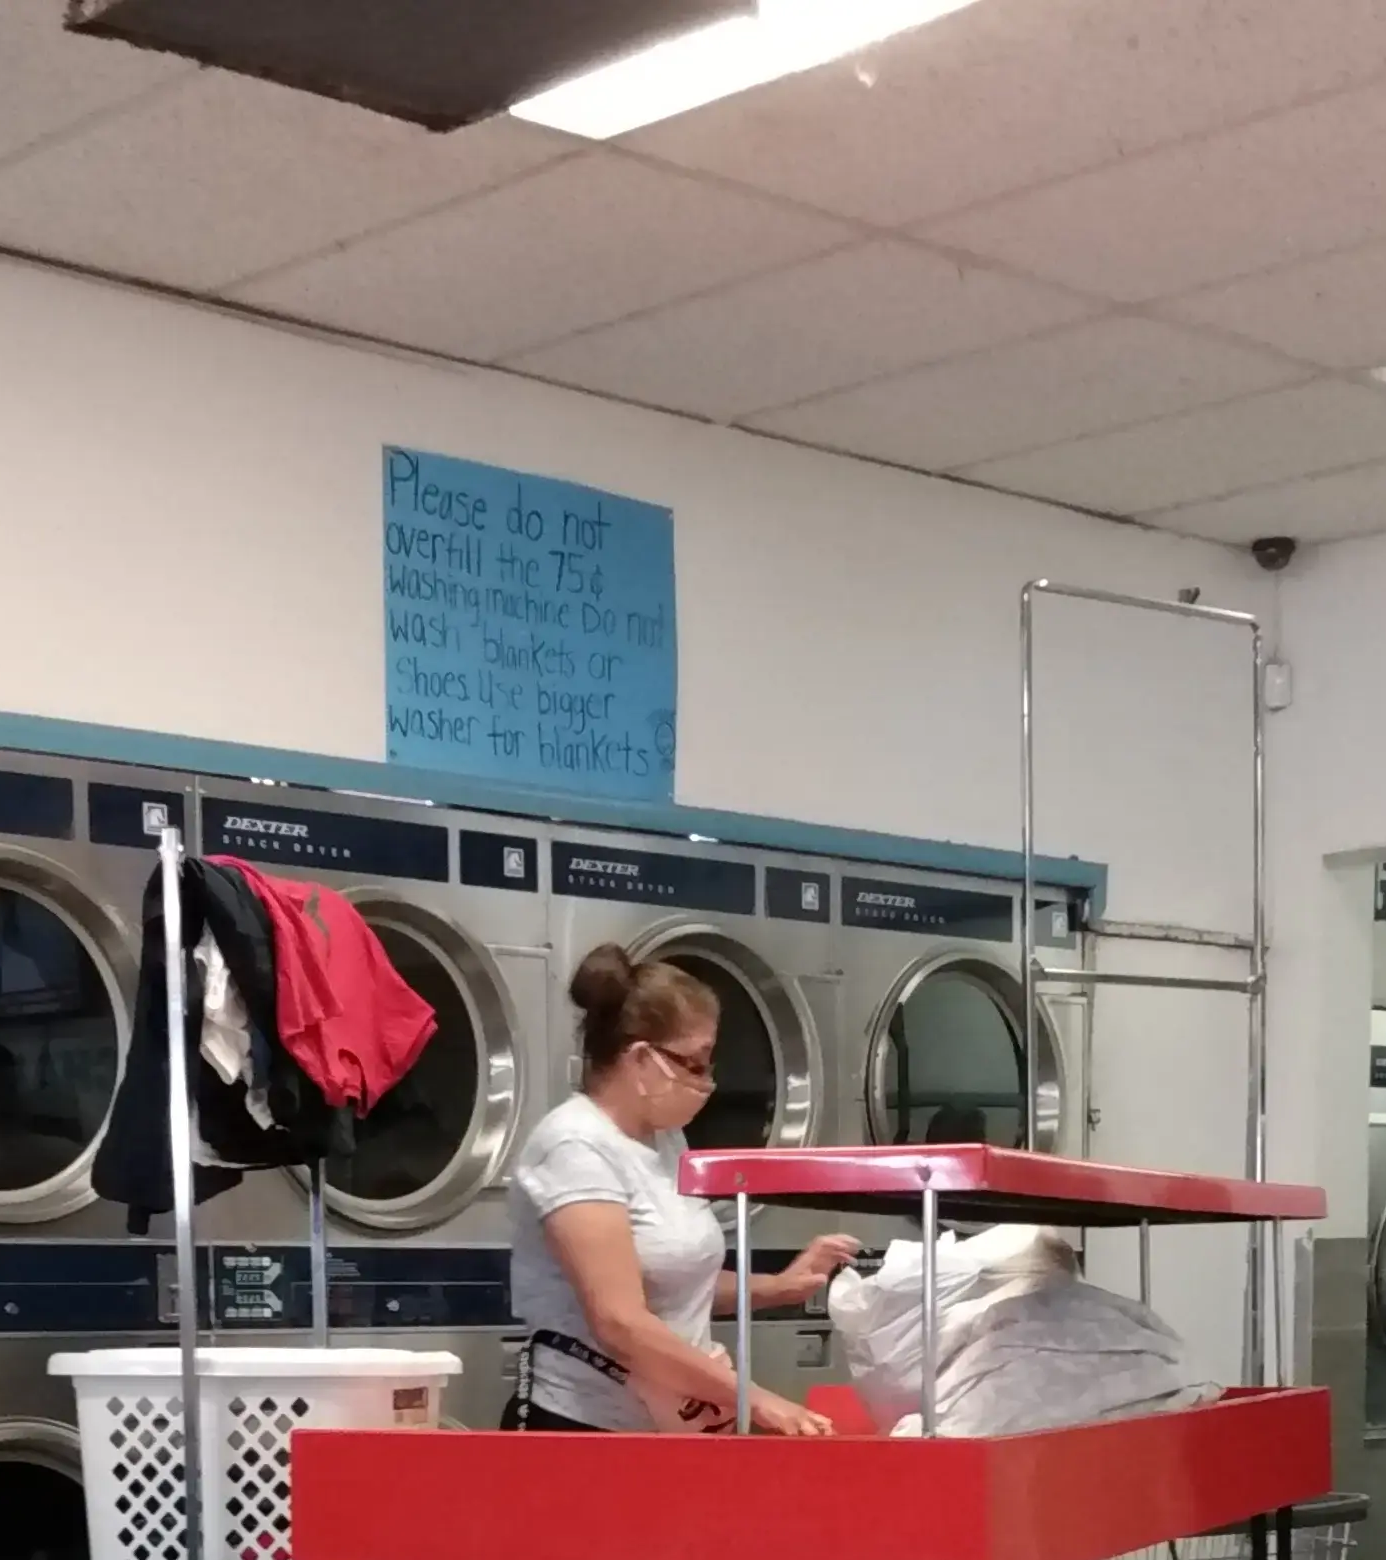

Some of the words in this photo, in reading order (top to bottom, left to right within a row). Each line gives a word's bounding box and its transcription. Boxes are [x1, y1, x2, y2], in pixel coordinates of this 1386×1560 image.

[388, 449, 487, 532] Please
[506, 481, 543, 541] do
[563, 501, 612, 550] not
[385, 521, 481, 577] overfill
[496, 541, 541, 588] the
[483, 620, 576, 679] blankets
[588, 653, 623, 683] or
[537, 681, 616, 735] bigger
[487, 715, 526, 759] for
[538, 722, 650, 777] blankets
[223, 815, 309, 838] DEXTER
[568, 857, 640, 876] DEXTER
[856, 892, 916, 908] DEXTER
